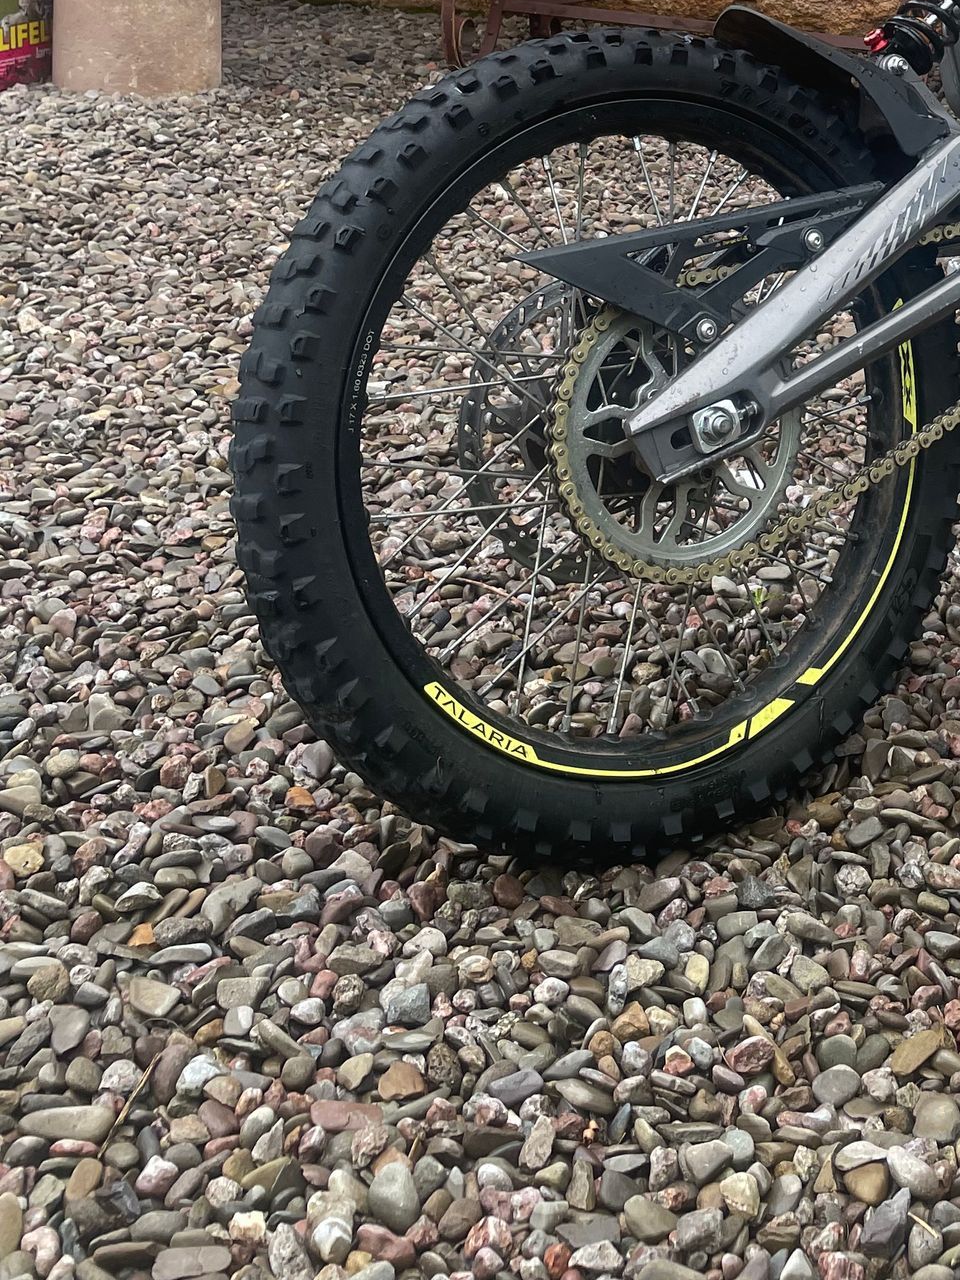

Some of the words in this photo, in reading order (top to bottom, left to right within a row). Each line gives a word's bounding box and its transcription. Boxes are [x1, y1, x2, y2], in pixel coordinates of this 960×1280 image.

[363, 328, 375, 351] DOT
[356, 353, 368, 377] 0323
[352, 378, 362, 399] 1.60
[348, 412, 356, 426] 17
[434, 684, 528, 760] TALARIA
